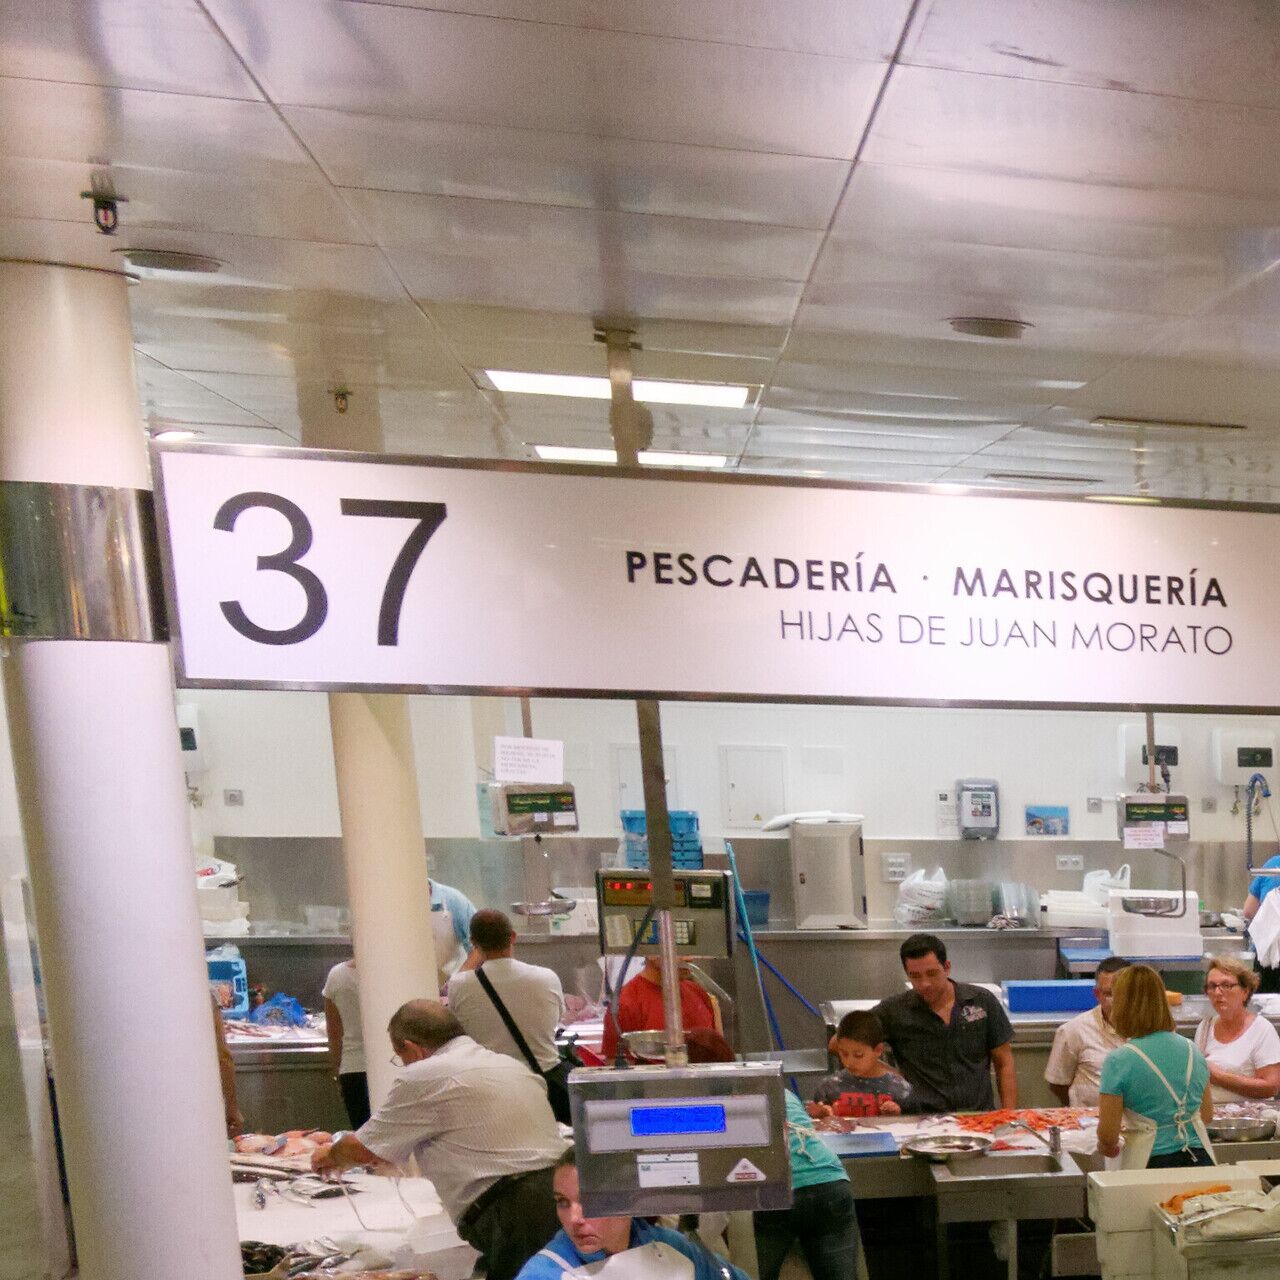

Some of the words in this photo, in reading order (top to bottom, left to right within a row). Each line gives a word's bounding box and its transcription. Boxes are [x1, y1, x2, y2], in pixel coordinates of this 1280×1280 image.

[213, 492, 448, 646] 37
[626, 550, 897, 593] PESCADERÍA
[952, 567, 1228, 608] MARISQUERÍA
[780, 610, 884, 643] HIJAS
[898, 614, 946, 645] DE
[959, 618, 1057, 648] JUAN
[1071, 622, 1234, 655] MORATO
